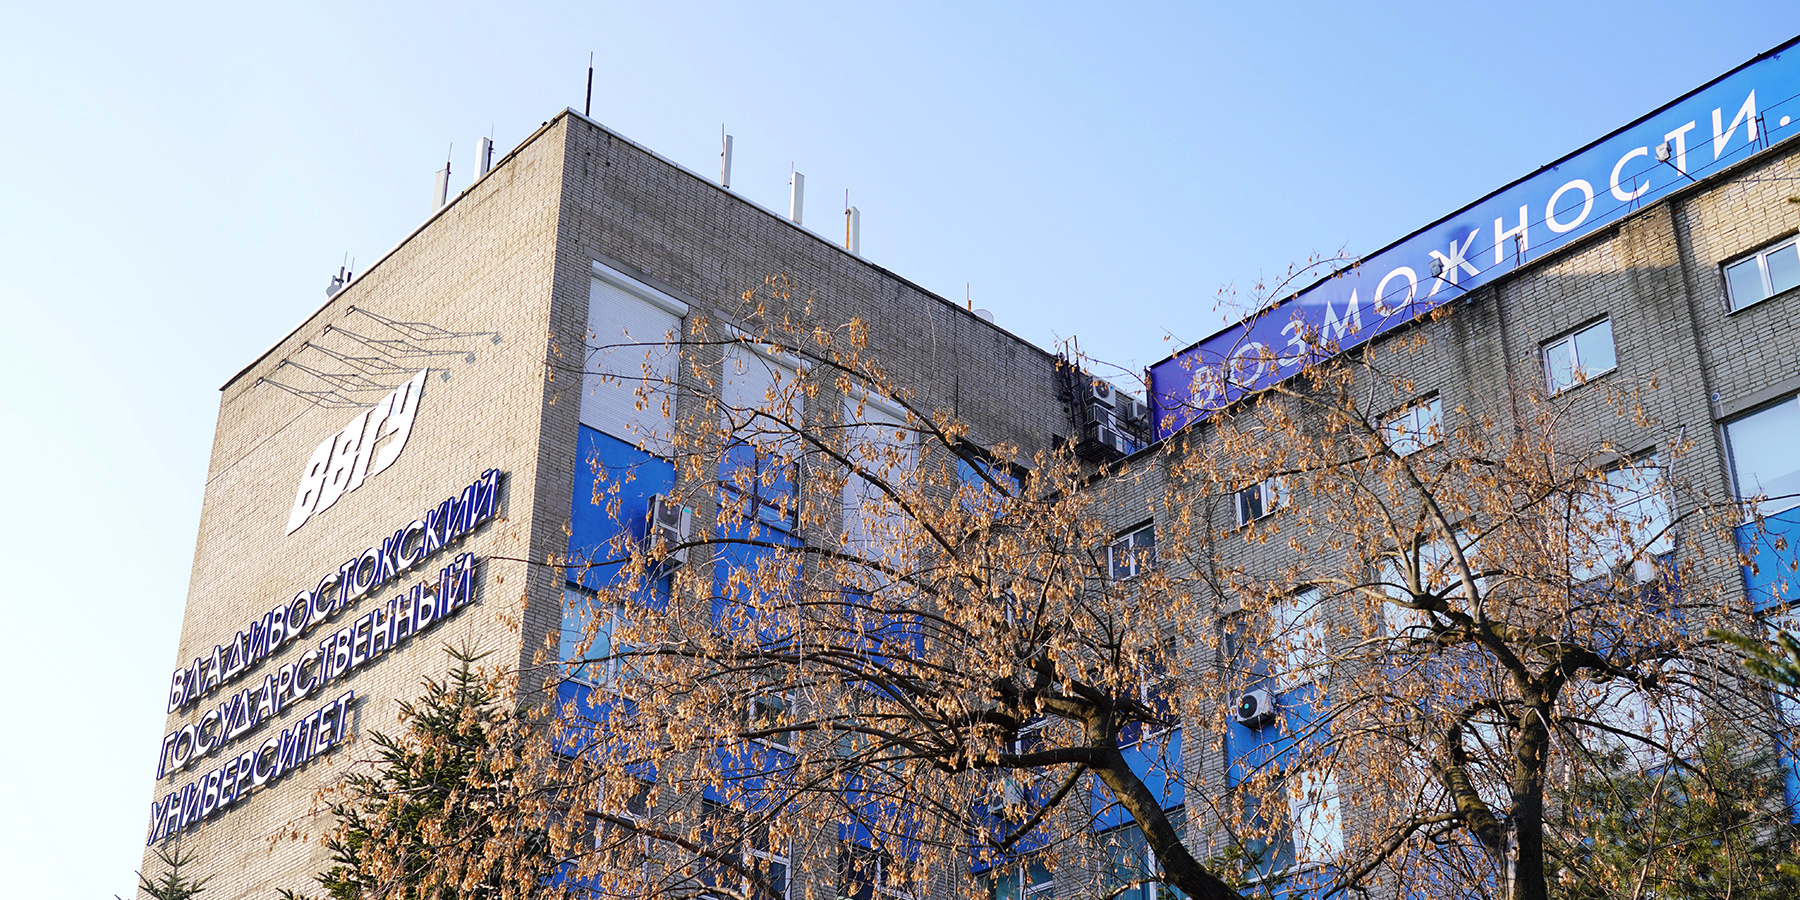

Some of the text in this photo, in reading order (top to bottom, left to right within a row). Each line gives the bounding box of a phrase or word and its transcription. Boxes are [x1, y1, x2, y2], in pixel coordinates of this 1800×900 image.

[286, 367, 429, 536] ВВГУ
[156, 553, 475, 780] ГОСУДАРСТВЕННЫЙ
[167, 468, 500, 714] ВЛАДИВОСТОКСКИЙ
[147, 690, 354, 846] УНИВЕРСИТЕТ
